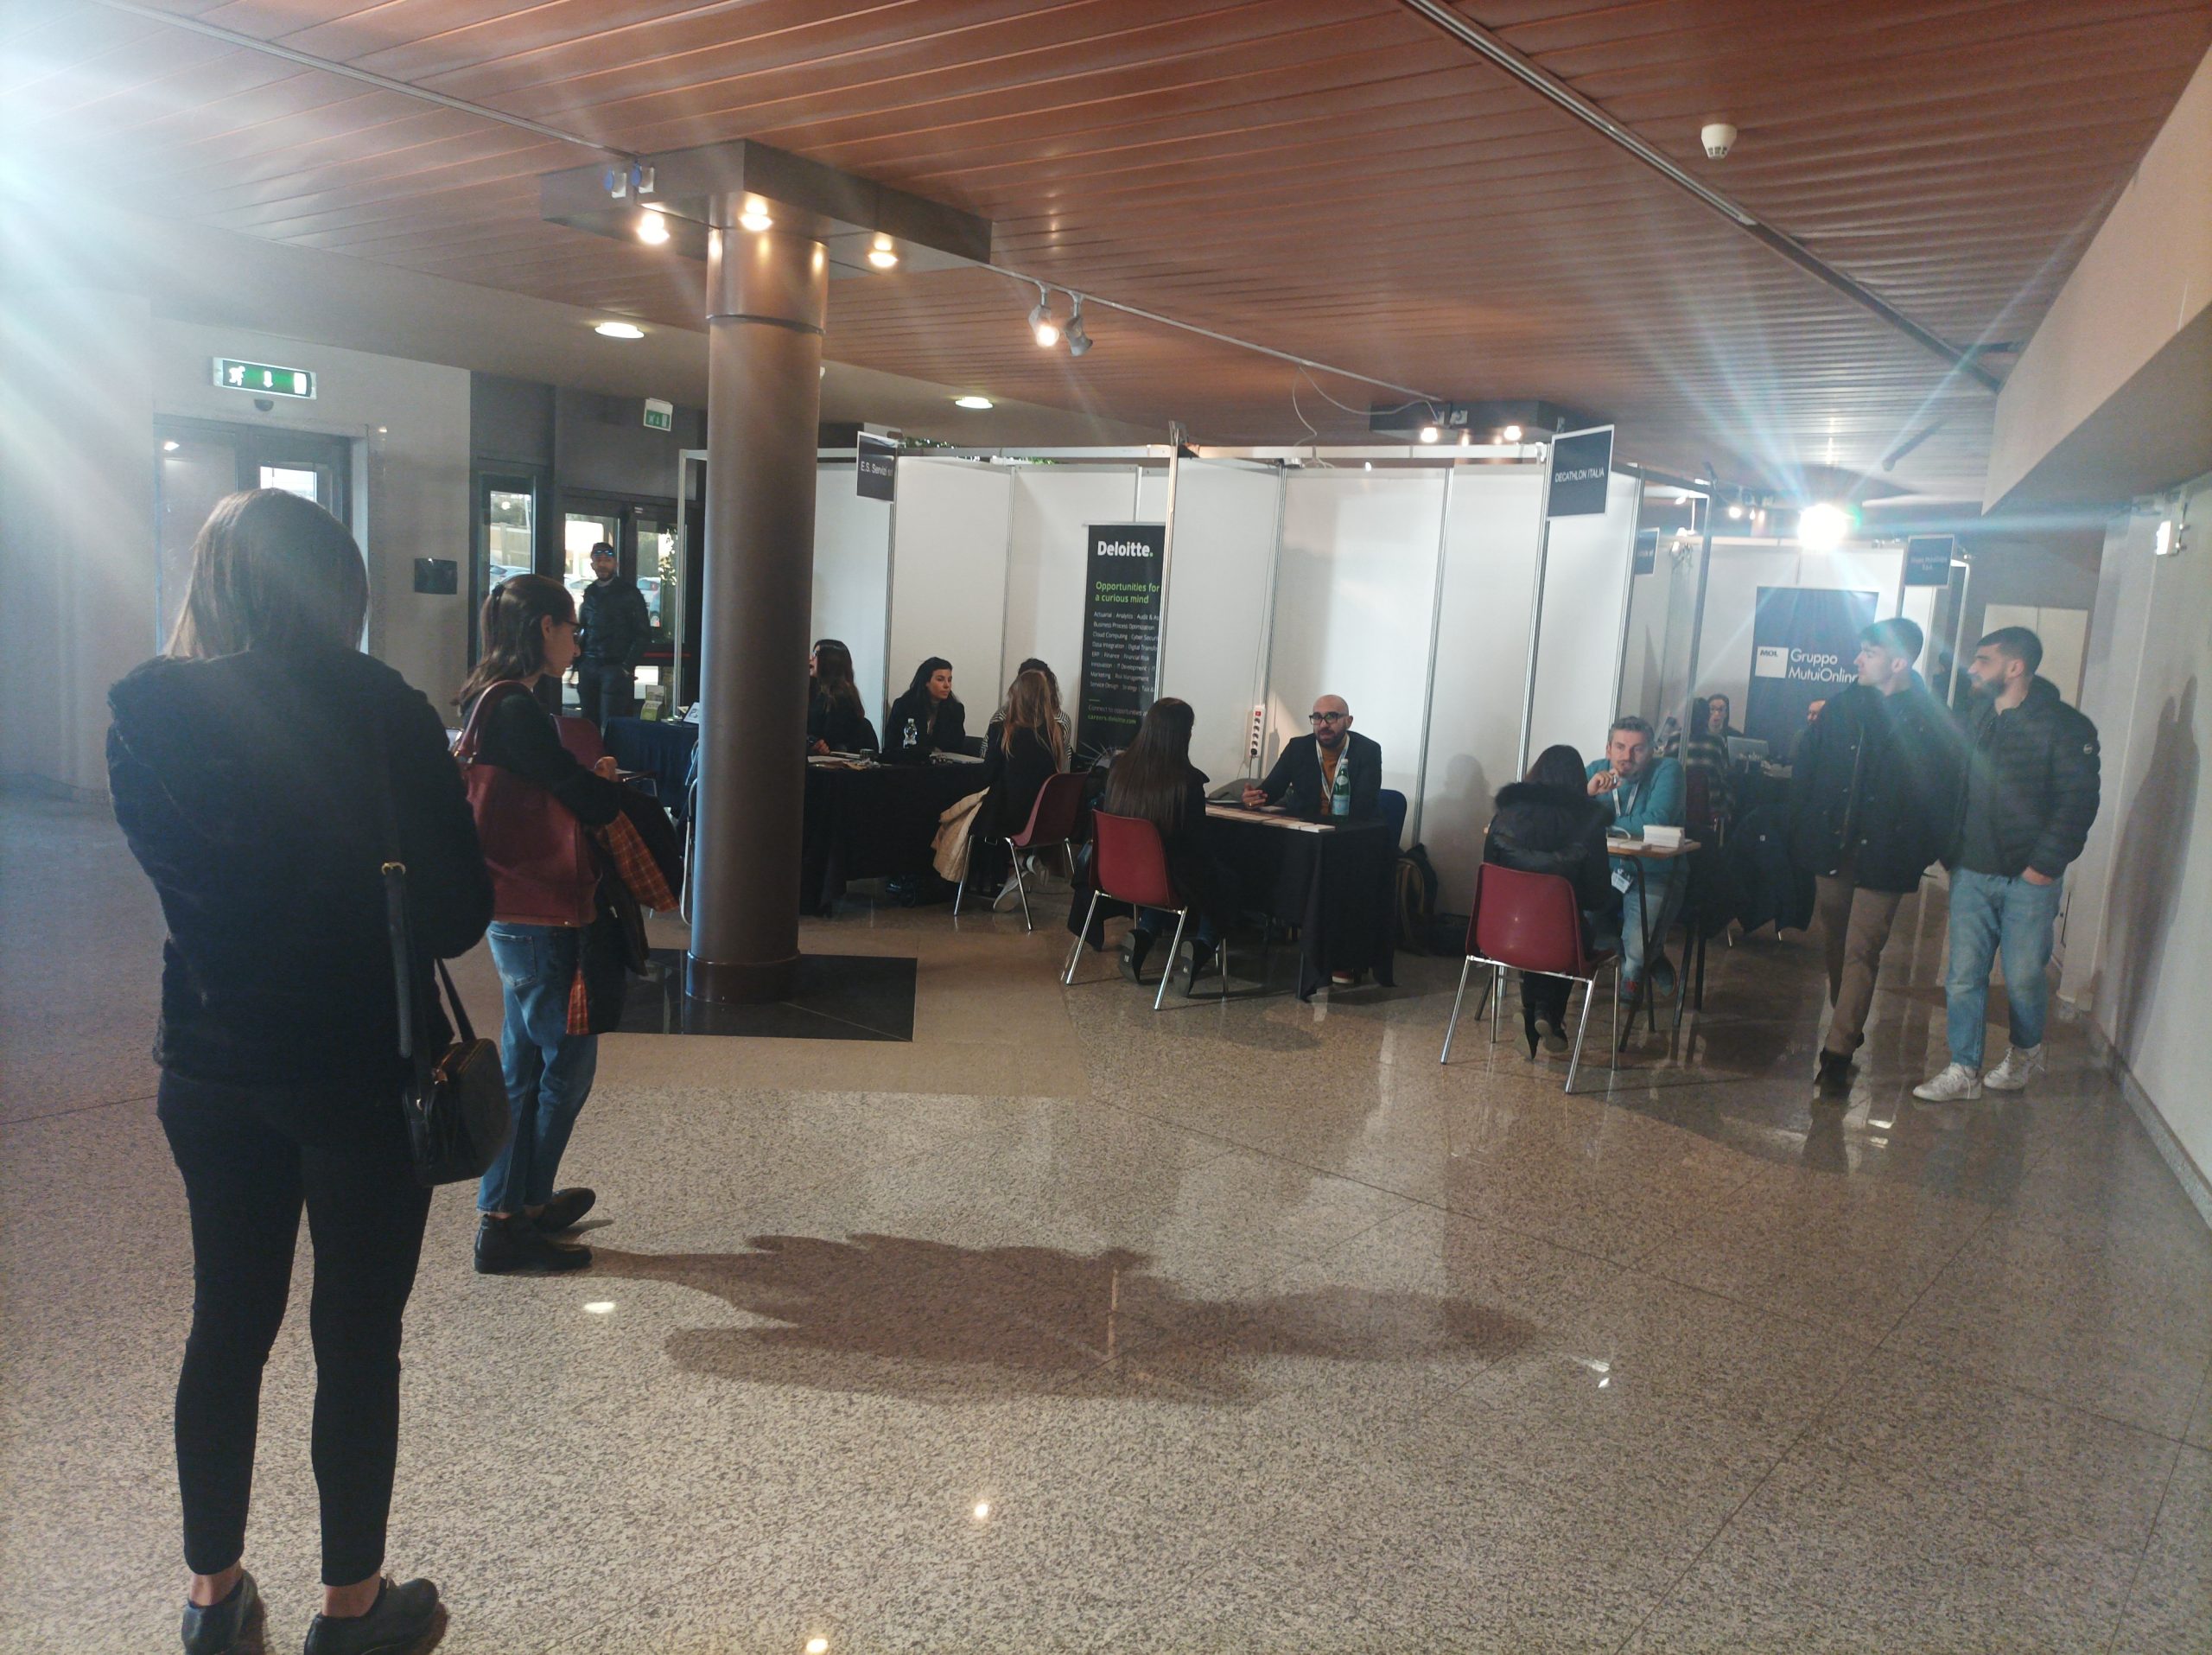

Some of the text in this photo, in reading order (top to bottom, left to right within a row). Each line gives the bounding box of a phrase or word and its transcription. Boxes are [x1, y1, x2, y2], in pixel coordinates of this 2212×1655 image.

[1555, 467, 1605, 482] DECATHLON ITALIA
[1097, 540, 1154, 557] Deloitte.
[1096, 581, 1160, 592] Opportunities for
[1101, 594, 1128, 602] curious
[1106, 632, 1128, 640] Computing
[1759, 649, 1779, 658] MOL
[1790, 648, 1838, 668] Gruppo
